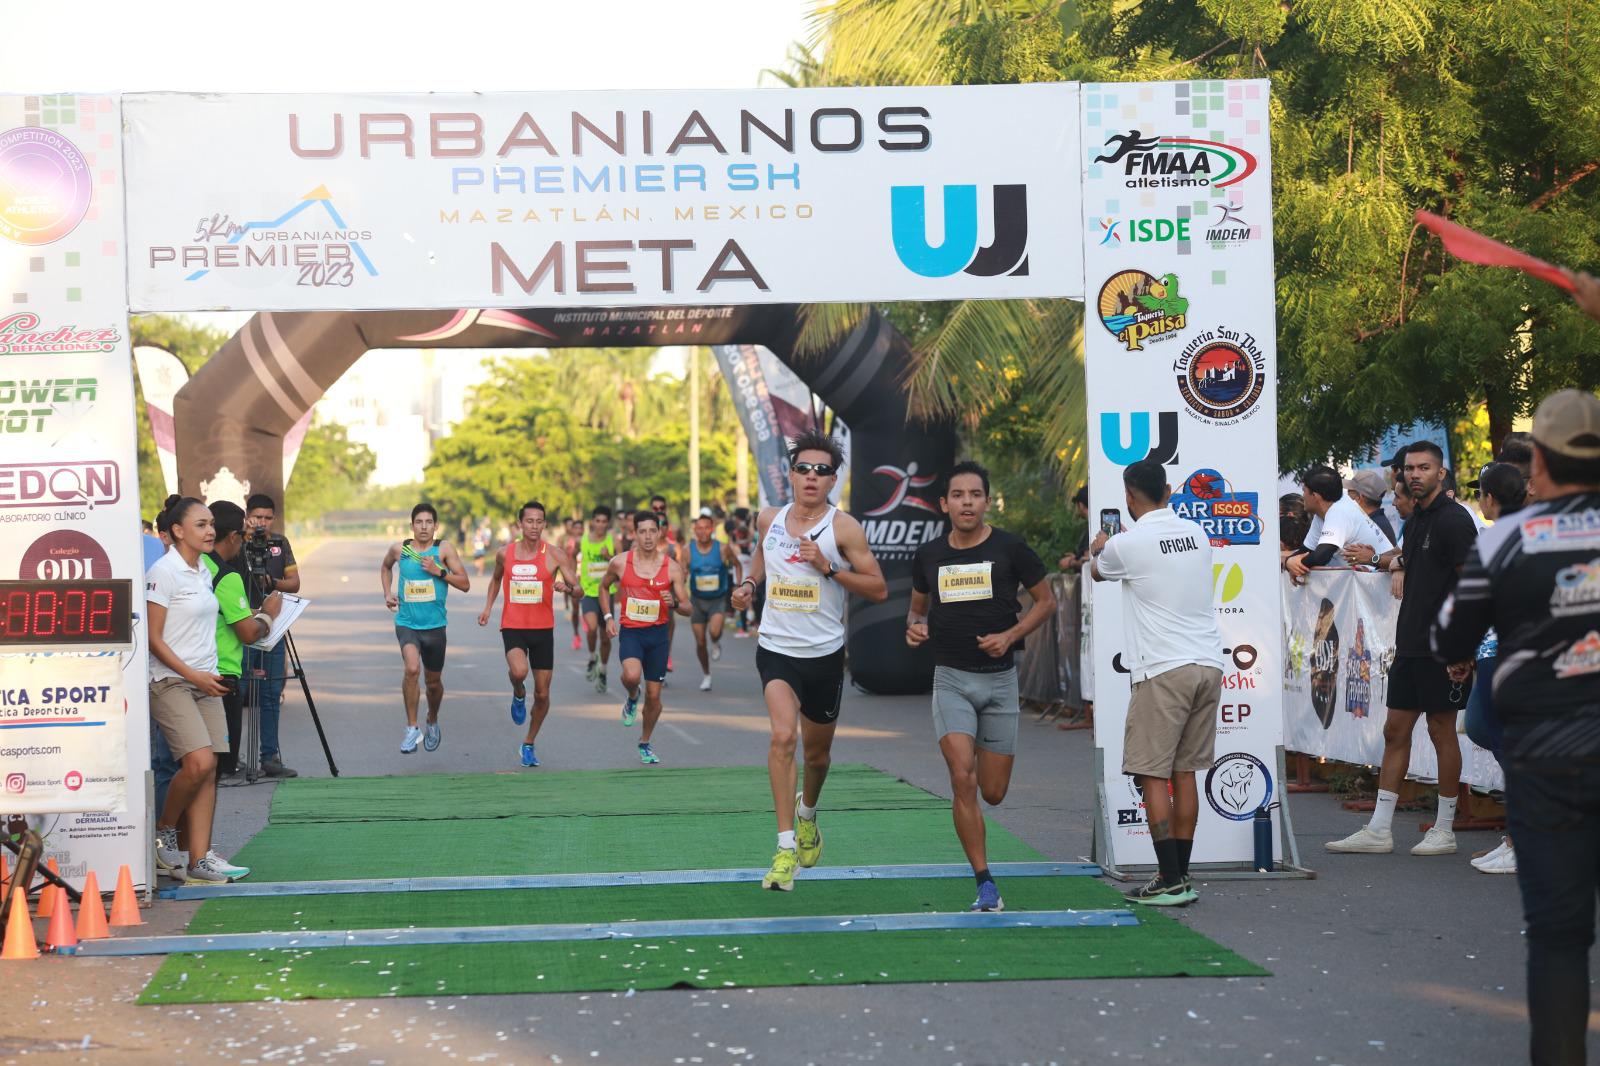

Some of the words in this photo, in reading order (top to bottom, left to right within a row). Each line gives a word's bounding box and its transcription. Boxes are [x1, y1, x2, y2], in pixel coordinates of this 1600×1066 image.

[288, 106, 932, 159] URBANIANOS
[1125, 151, 1211, 175] FMAA
[452, 164, 706, 194] PREMIER
[1125, 176, 1210, 188] atletismo
[674, 203, 813, 222] MEXICO
[252, 230, 372, 241] URBANIANOS
[1129, 218, 1191, 242] ISDE
[1206, 228, 1250, 240] IMDEM
[149, 244, 351, 268] PREMIER
[296, 261, 354, 287] 2023
[491, 238, 771, 295] META
[553, 313, 606, 323] INSTITUTO
[608, 311, 665, 322] MUNICIPAL
[666, 310, 686, 321] DEL
[687, 308, 734, 320] DEPORTE
[583, 323, 704, 336] MAZATLÁN
[12, 344, 100, 353] REFACCIONES
[1217, 325, 1239, 341] San
[1240, 333, 1265, 370] Pablo
[54, 511, 86, 521] CLÍNICO
[1214, 504, 1249, 515] ISCOS
[1159, 536, 1198, 555] OFICIAL
[37, 558, 94, 580] ODI
[950, 576, 985, 587] CARVAJAL
[779, 587, 814, 598] VIZCARRA
[637, 605, 649, 615] 154
[0, 688, 30, 705] ICA
[42, 686, 110, 704] SPORT
[24, 706, 78, 716] Deportiva
